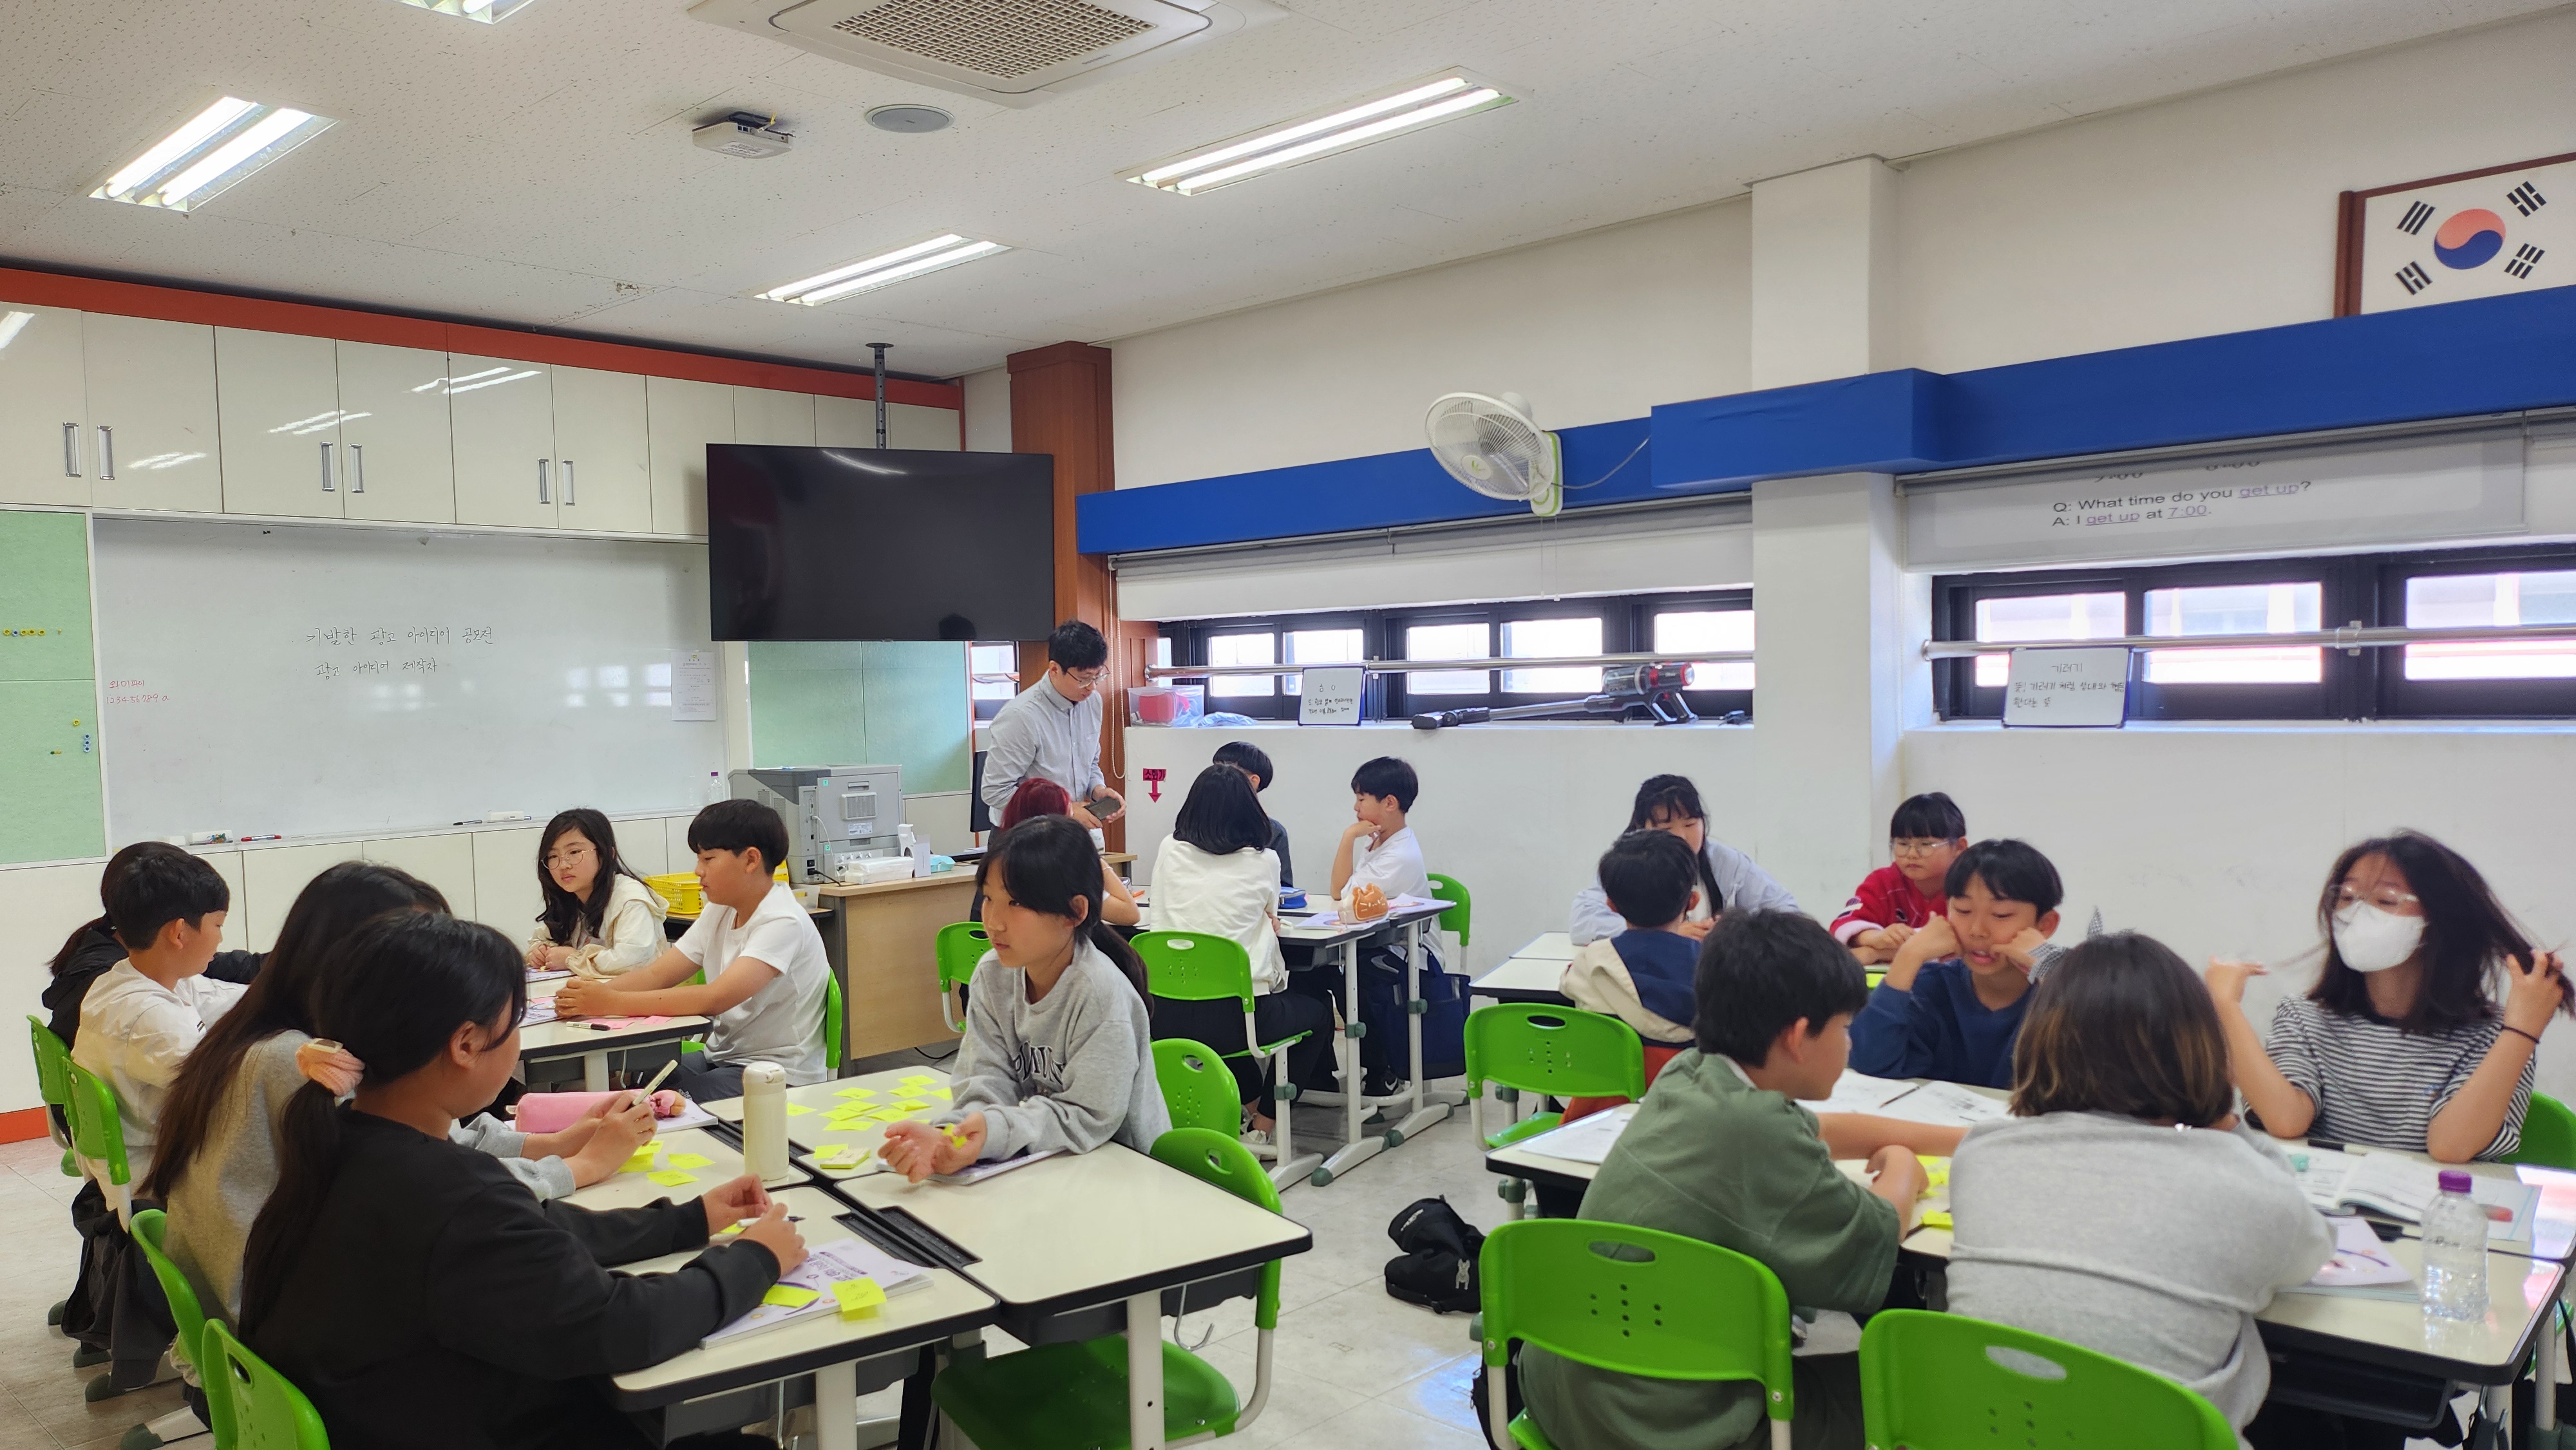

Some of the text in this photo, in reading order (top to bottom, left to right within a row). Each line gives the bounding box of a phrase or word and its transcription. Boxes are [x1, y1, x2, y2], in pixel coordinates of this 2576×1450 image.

[2053, 480, 2312, 513] Q: What time do you get up?
[2052, 504, 2212, 526] A: I get up at 7:00.
[306, 626, 494, 646] 기발한 광고 아이디어 공모전
[315, 657, 438, 680] 광고 아이디어 제작자
[2051, 663, 2083, 673] 기러기
